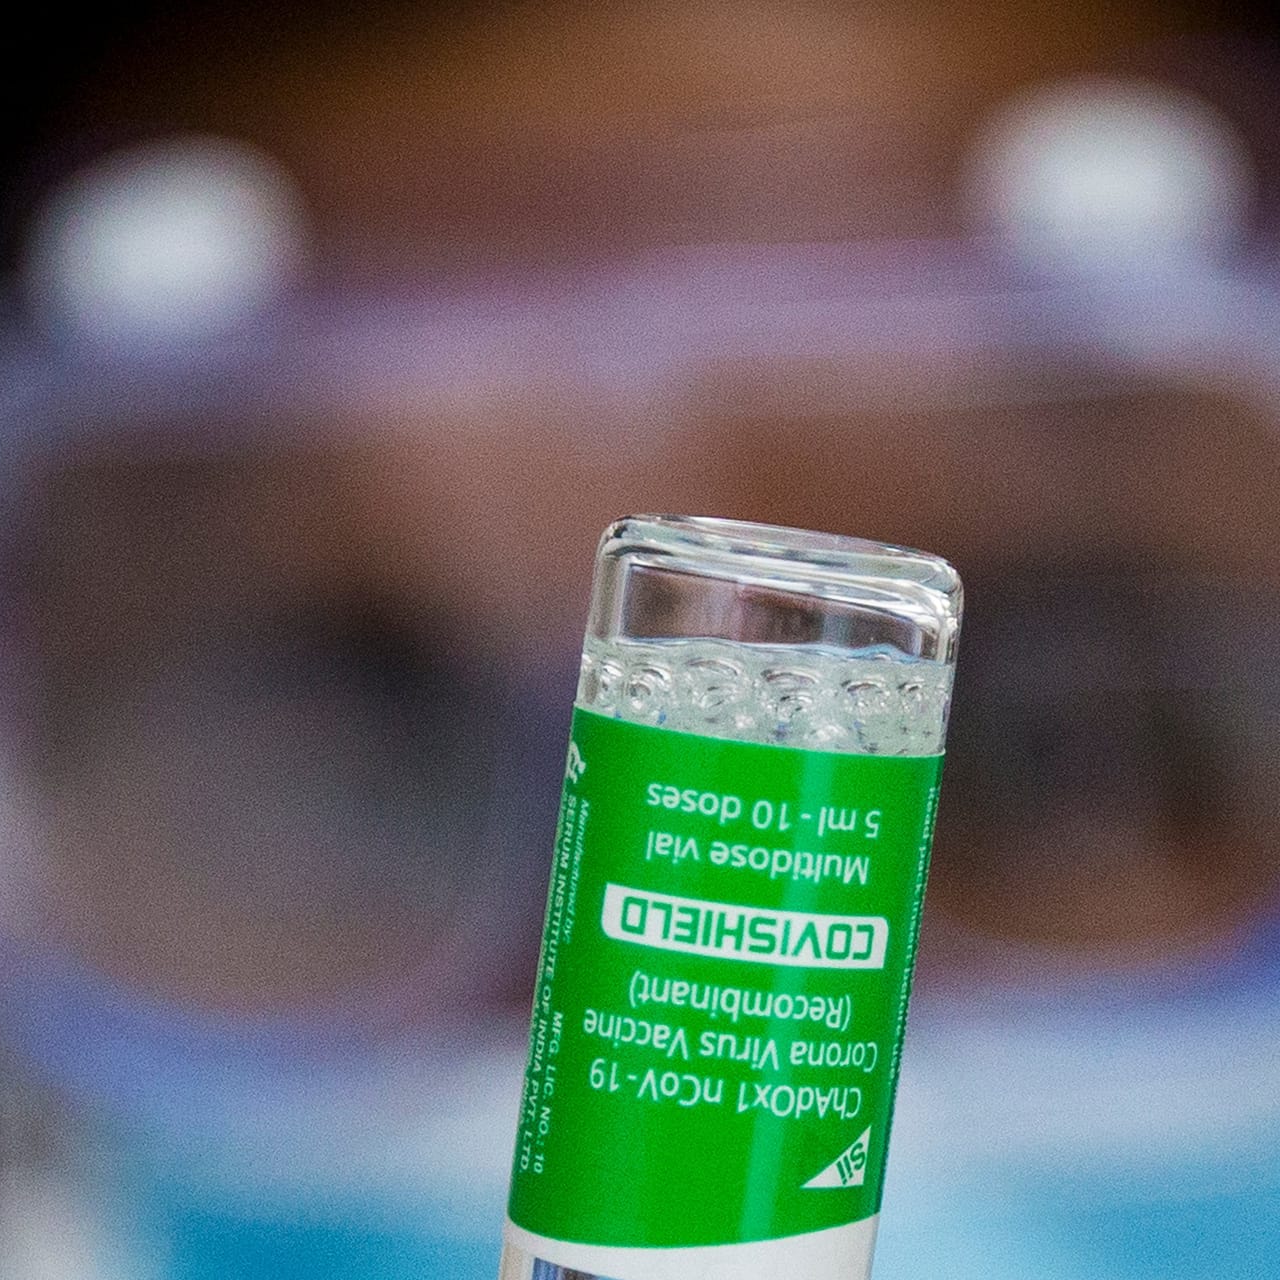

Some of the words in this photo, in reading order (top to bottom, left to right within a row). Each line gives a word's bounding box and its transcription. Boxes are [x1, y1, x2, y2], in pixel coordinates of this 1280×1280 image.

[647, 783, 741, 824] doses
[752, 800, 790, 831] 10
[817, 806, 856, 836] ml
[865, 810, 881, 838] 5
[560, 795, 577, 869] SERUM
[646, 831, 699, 864] vial
[567, 798, 589, 914] Manufactured
[710, 841, 869, 885] Multidose
[545, 874, 566, 979] INSTITUTE
[620, 895, 875, 961] COVISHIELD
[541, 986, 551, 1012] OF
[629, 970, 851, 1032] (Recombinant)
[534, 1019, 547, 1072] INDIA
[548, 1012, 563, 1058] MFG.
[583, 1008, 688, 1060] Vaccine
[699, 1032, 779, 1071] Virus
[790, 1041, 877, 1072] Corona
[526, 1079, 539, 1122] PVT.
[542, 1065, 556, 1100] LIC.
[737, 1083, 862, 1119] ChAdOx1
[534, 1153, 544, 1174] 10
